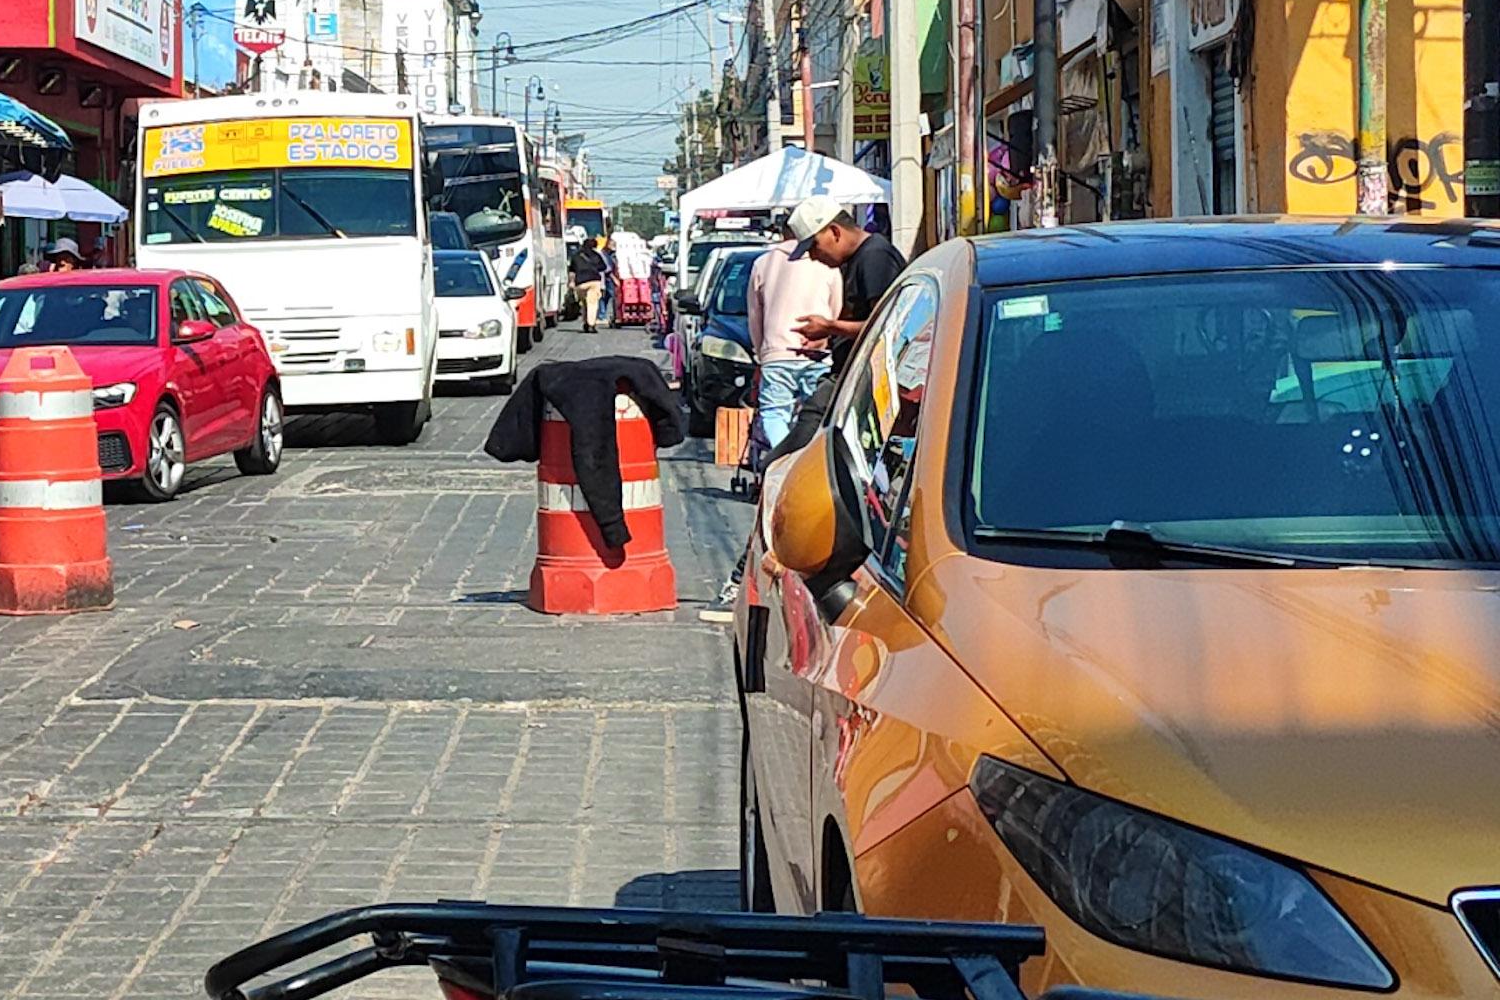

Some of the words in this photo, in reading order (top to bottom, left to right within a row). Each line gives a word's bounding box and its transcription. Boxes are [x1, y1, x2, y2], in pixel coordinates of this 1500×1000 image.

[235, 31, 284, 43] TECATE
[423, 8, 437, 115] VIDRIOS
[290, 124, 326, 140] PZA
[329, 124, 399, 140] LORETO
[288, 143, 399, 161] ESTADIOS
[219, 187, 272, 201] CENTRO
